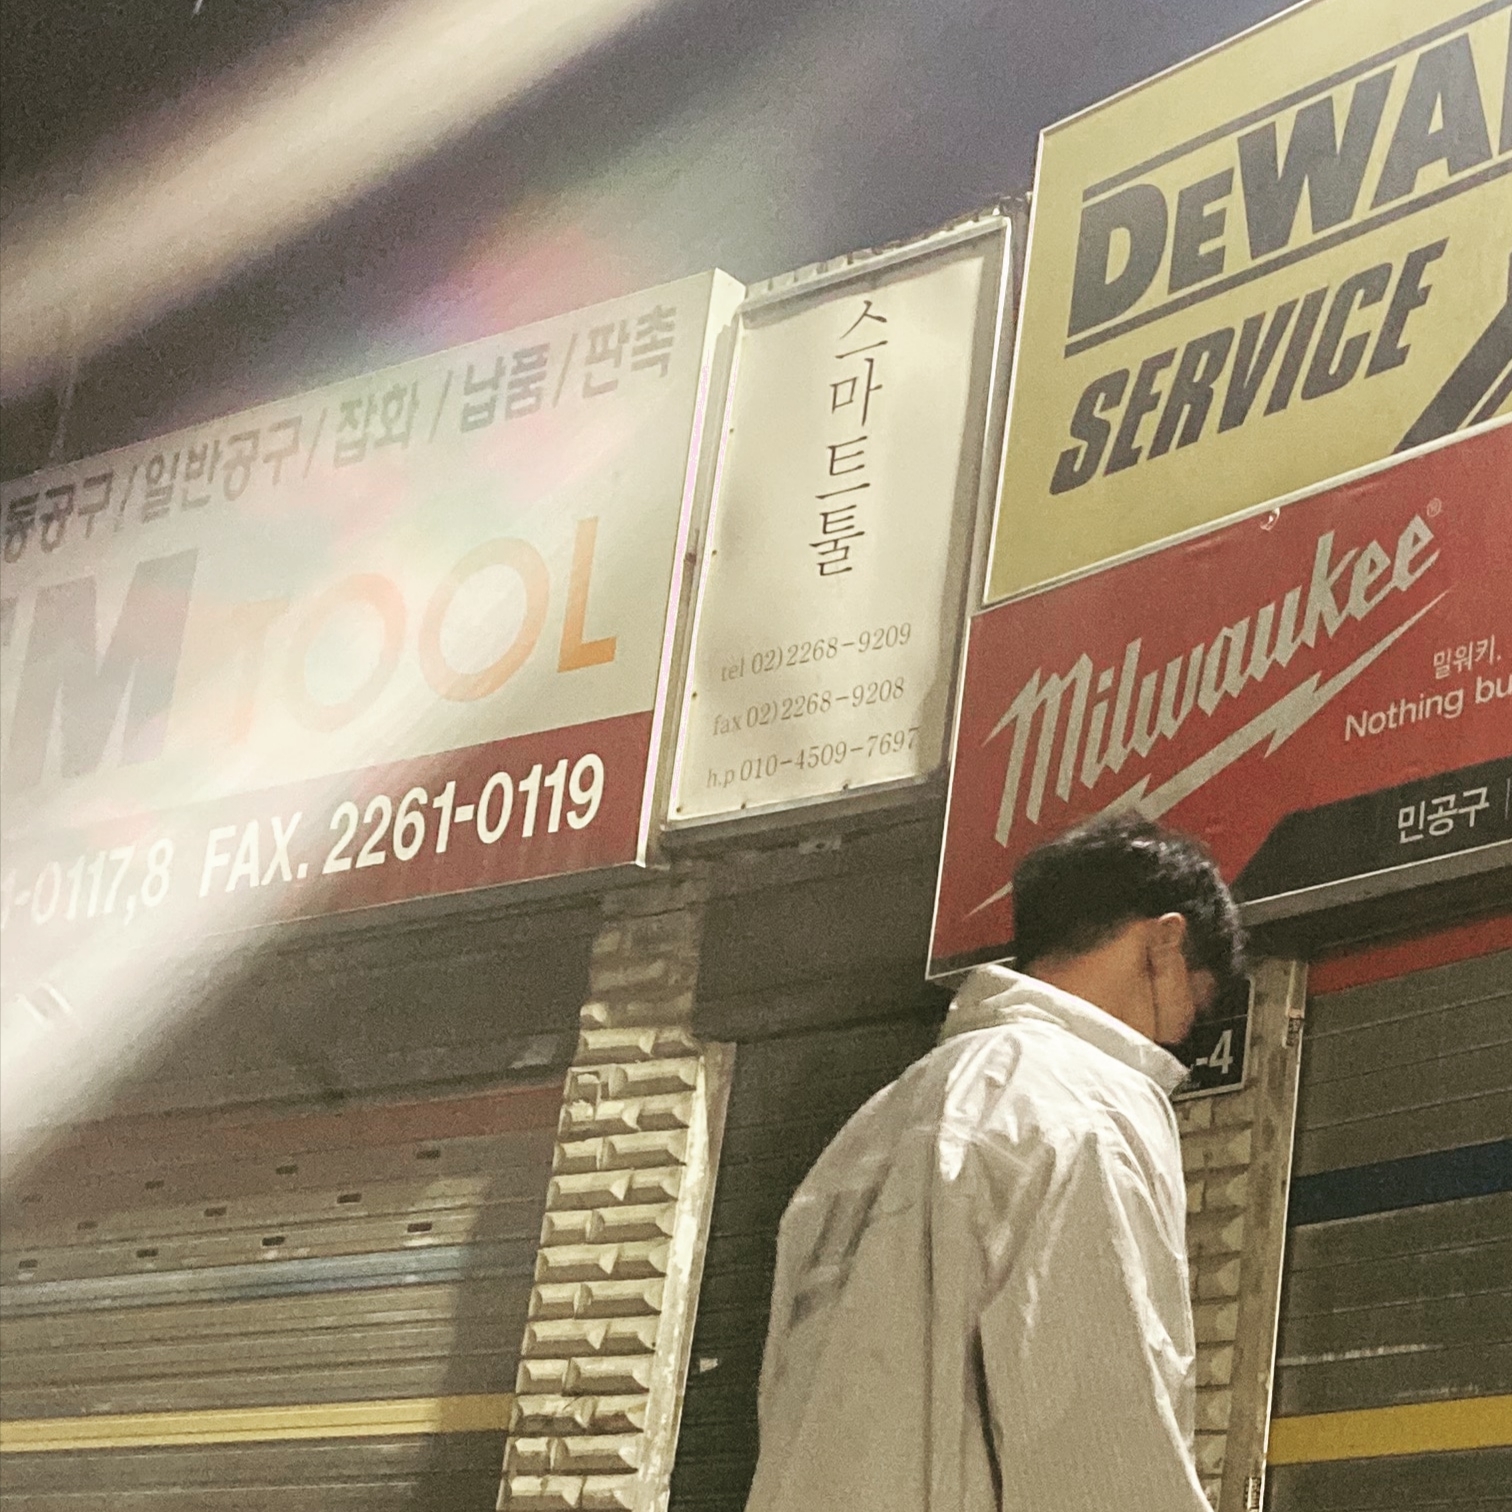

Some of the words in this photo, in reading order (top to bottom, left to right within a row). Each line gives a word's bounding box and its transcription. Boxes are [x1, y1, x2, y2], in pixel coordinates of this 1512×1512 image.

[1049, 236, 1450, 495] SERVICE
[808, 299, 889, 577] 스마트툴
[721, 653, 745, 682] tel
[751, 622, 912, 676] 02)2268-9209
[980, 513, 1441, 849] Milwaukee
[712, 713, 742, 737] fax
[746, 676, 905, 729] 02)2268-9208
[1344, 687, 1465, 742] Nothing
[739, 726, 921, 782] 010-4509-7697
[199, 811, 308, 898] FAX.
[321, 752, 605, 876] 2261-0119
[1396, 786, 1491, 845] 민공구
